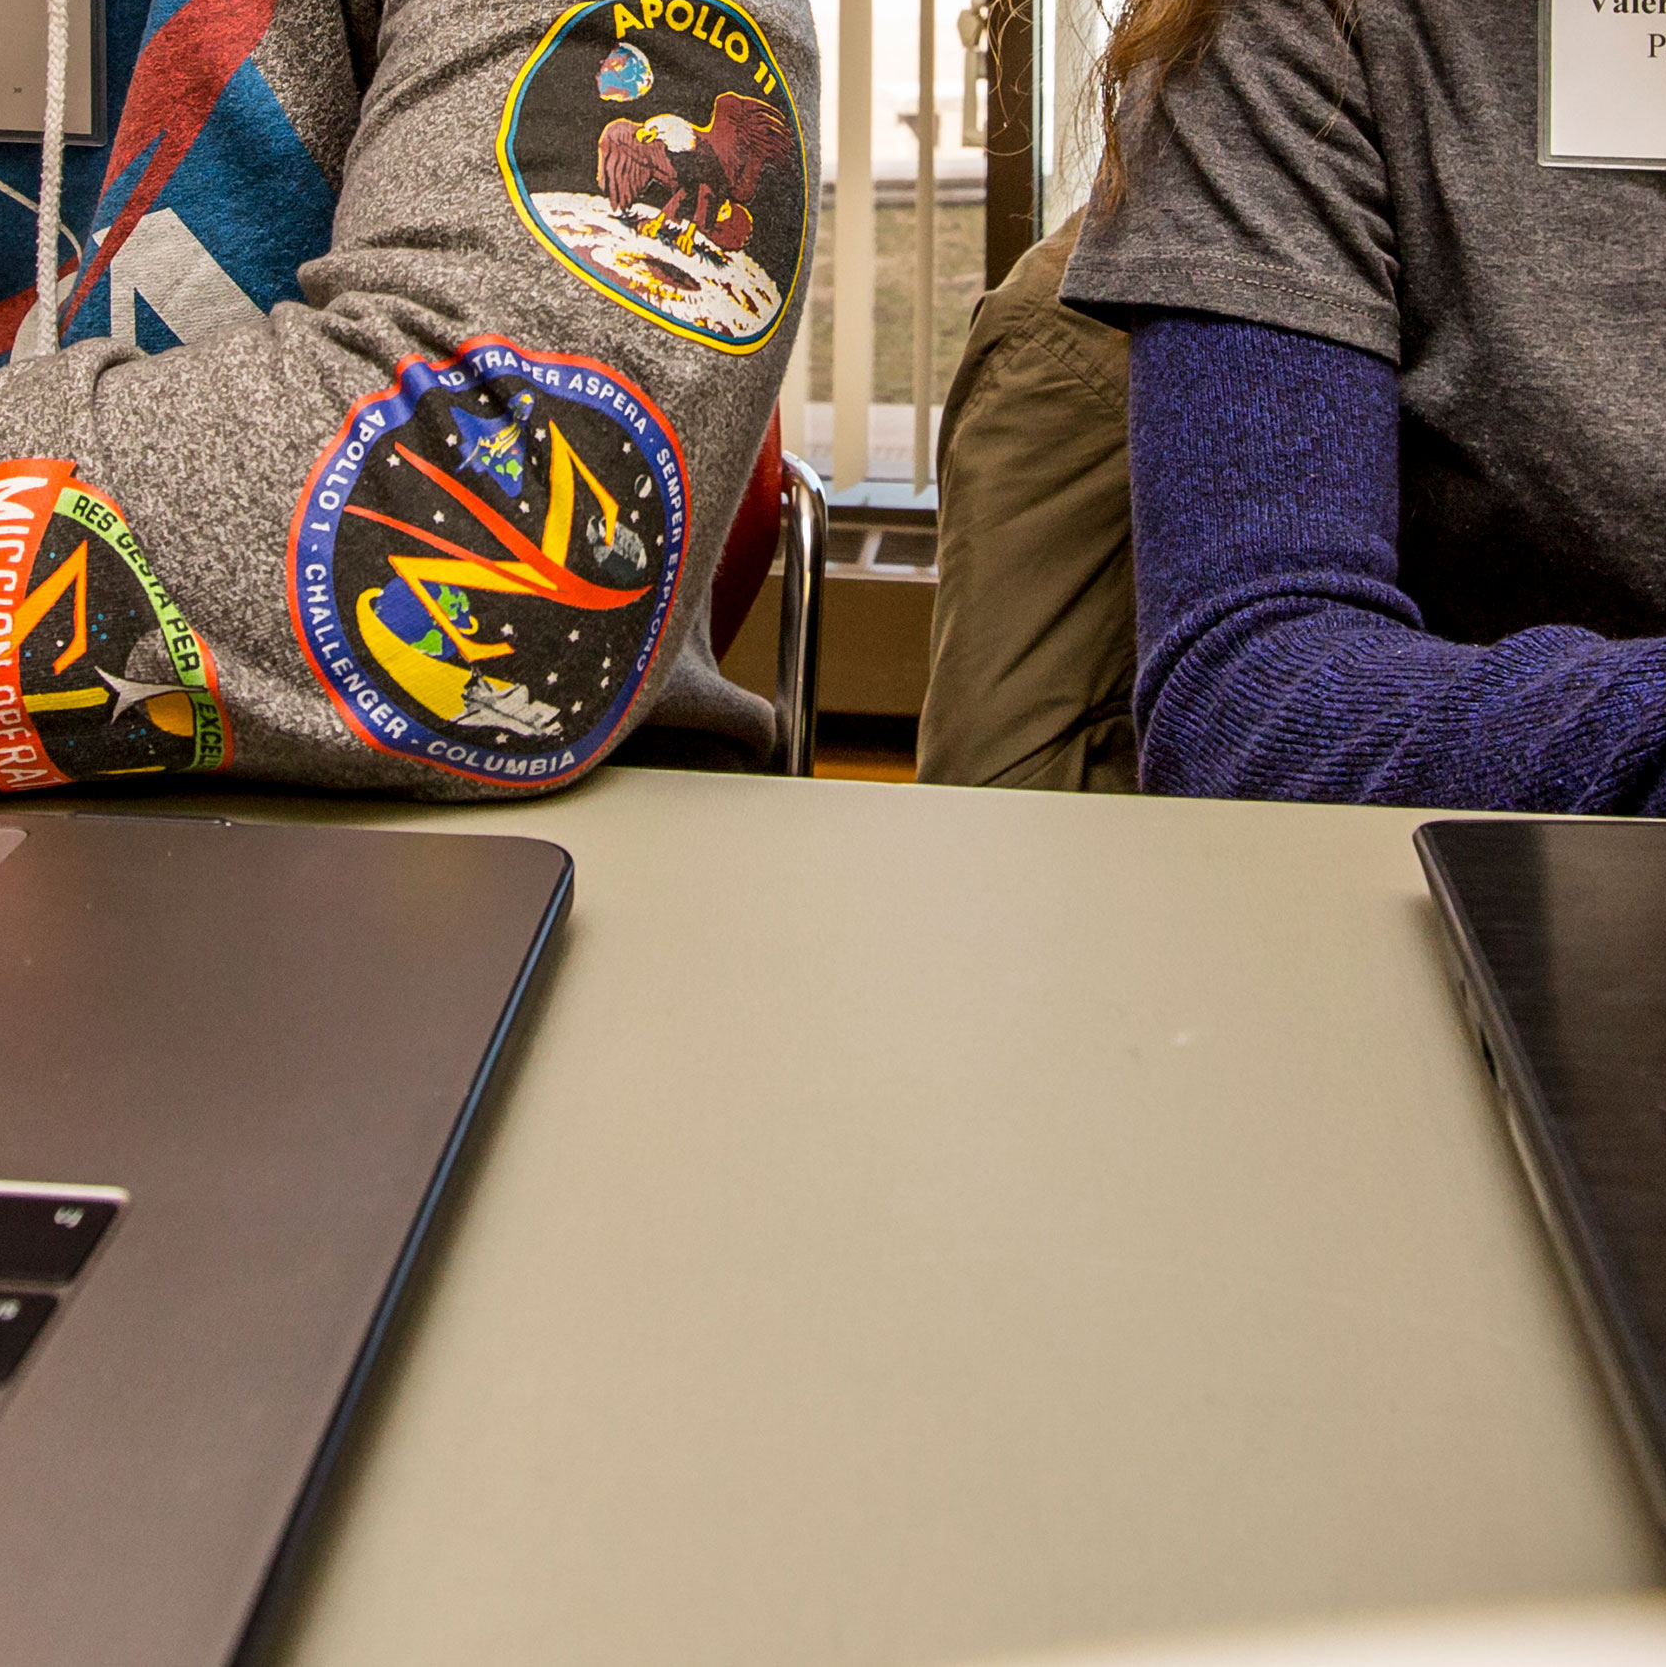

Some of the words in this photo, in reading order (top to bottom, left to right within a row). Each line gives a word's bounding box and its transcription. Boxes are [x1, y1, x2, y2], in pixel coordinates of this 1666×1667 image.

[752, 60, 778, 96] 11
[318, 409, 386, 511] APOLLO
[521, 359, 561, 387] PER
[567, 373, 648, 436] ASPERA
[655, 447, 684, 545] SEMPER
[309, 521, 331, 533] 1
[72, 494, 119, 533] RES
[166, 616, 201, 673] PER
[304, 563, 410, 740] CHALLENGER
[427, 739, 577, 777] COLUMBIA
